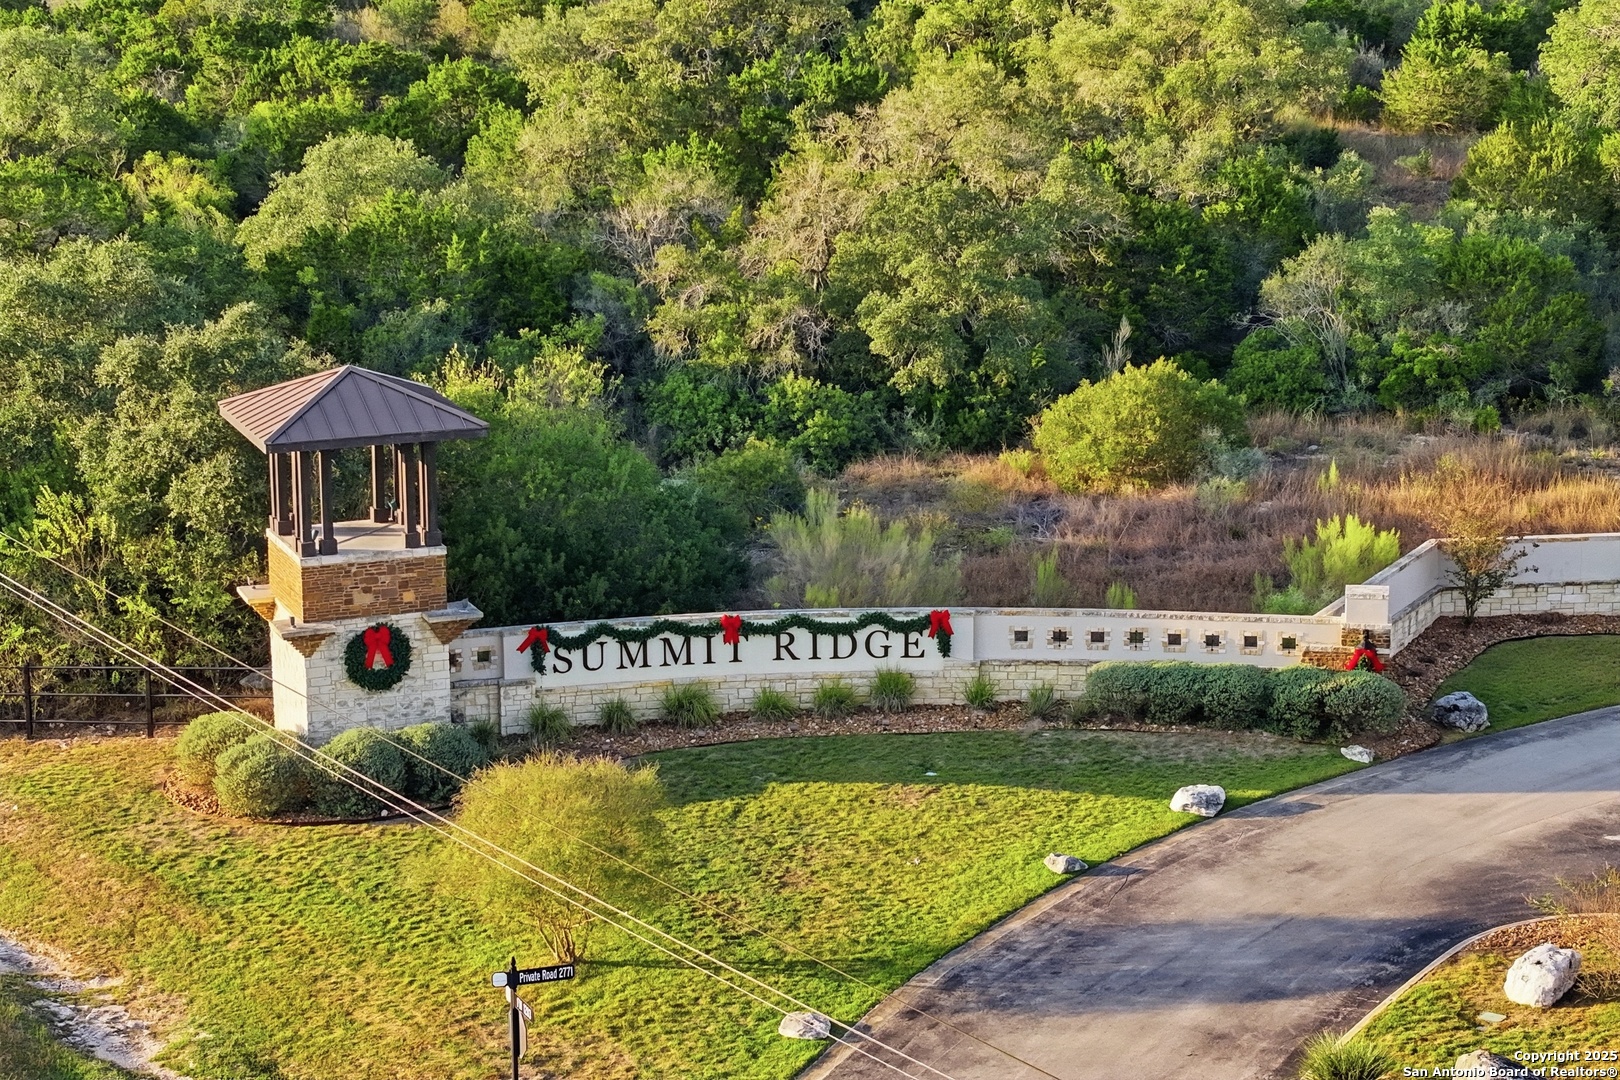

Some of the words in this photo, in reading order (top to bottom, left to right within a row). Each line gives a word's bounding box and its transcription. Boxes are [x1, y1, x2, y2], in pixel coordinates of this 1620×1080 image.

[553, 634, 749, 674] SUMMIT
[772, 630, 926, 661] RIDGE
[519, 972, 541, 983] Private
[542, 969, 558, 980] Road
[559, 966, 574, 978] 2771
